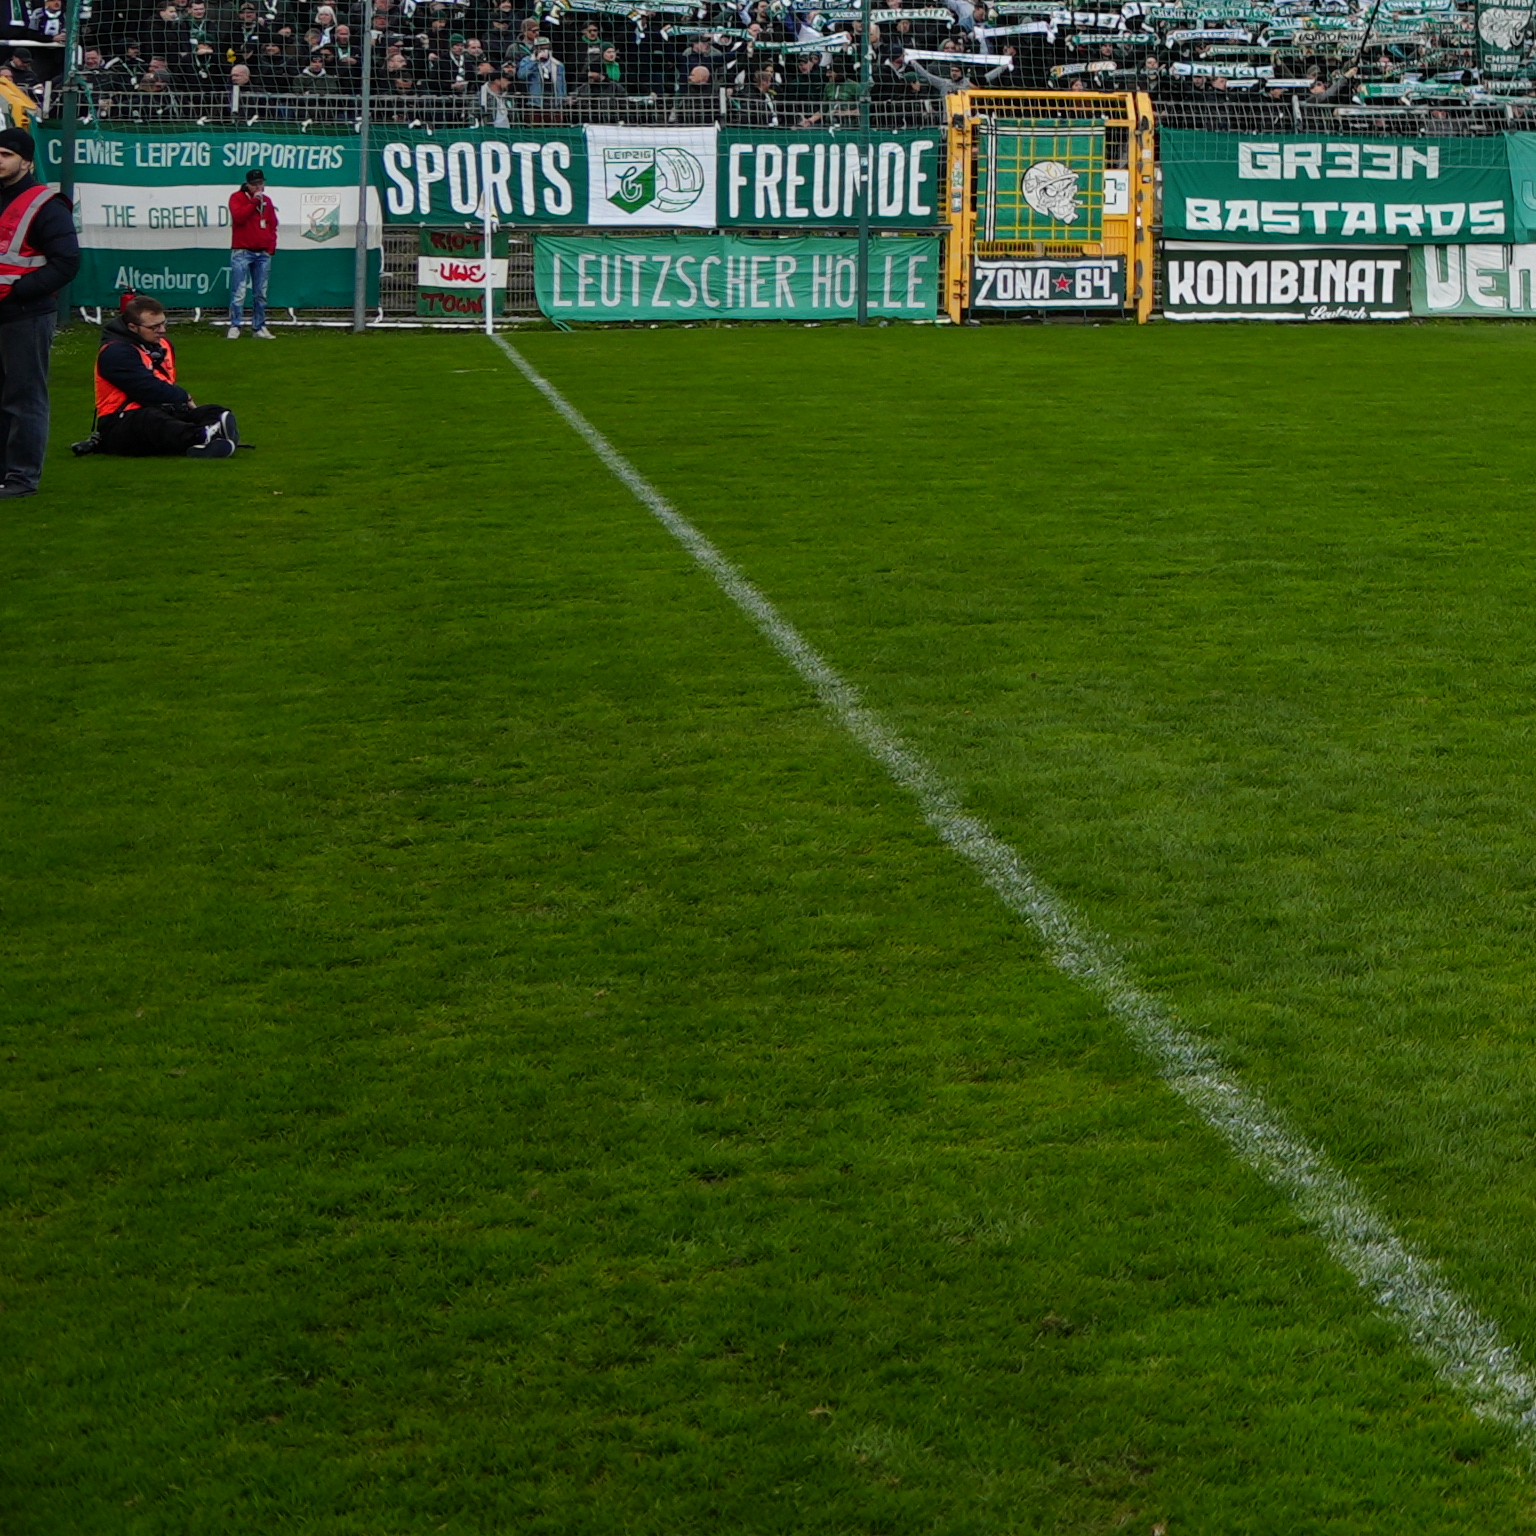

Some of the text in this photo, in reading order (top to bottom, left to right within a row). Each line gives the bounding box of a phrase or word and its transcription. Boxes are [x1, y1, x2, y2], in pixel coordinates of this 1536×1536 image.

[48, 138, 345, 170] CEMIE LEIPZIG SUPPORTERS
[607, 150, 652, 160] LEIPZIG
[382, 141, 572, 216] SPORTS
[728, 140, 934, 218] FREUNDE
[102, 204, 136, 228] THE
[150, 205, 208, 230] GREEN
[1184, 196, 1505, 237] BASTARDS
[553, 245, 928, 309] LEUTZSCHER HÖLE
[974, 267, 1113, 301] ZONA 64
[1167, 259, 1401, 306] KOMBINAT
